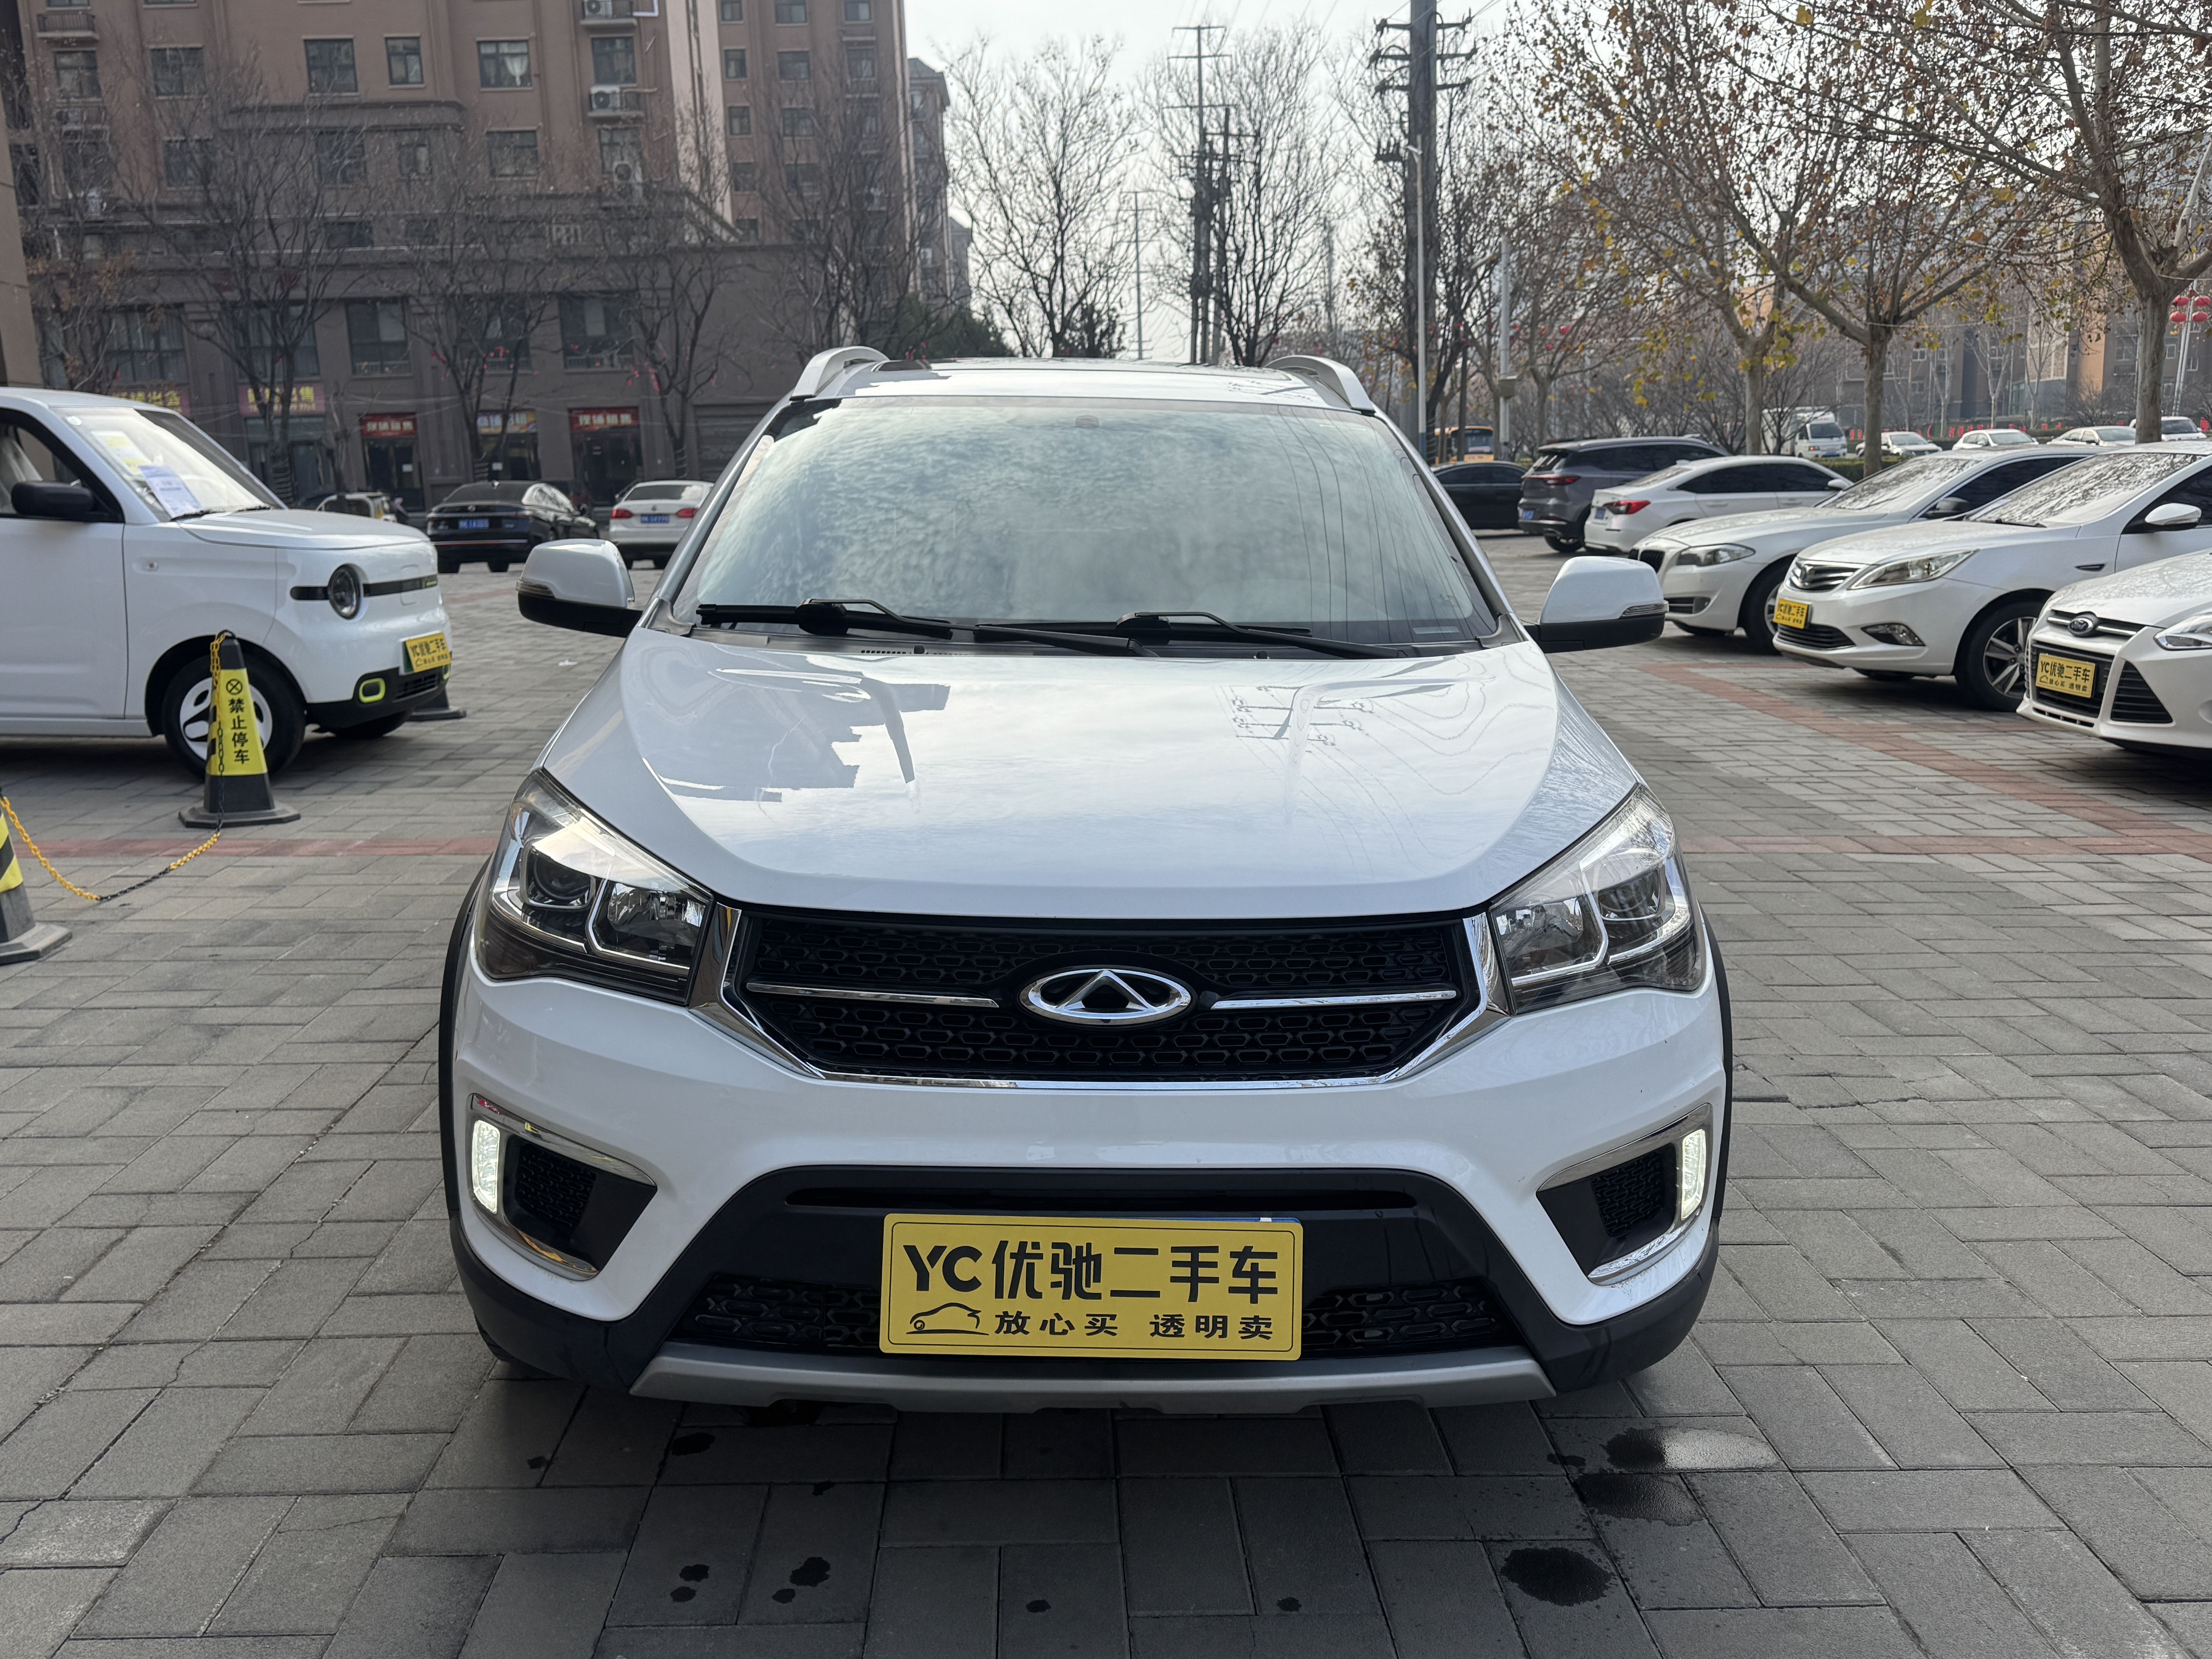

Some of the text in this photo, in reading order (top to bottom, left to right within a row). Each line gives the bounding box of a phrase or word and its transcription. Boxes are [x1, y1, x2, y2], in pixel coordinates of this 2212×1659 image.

[228, 698, 250, 764] 禁止停车
[903, 1240, 1278, 1304] YC优驰二手车
[994, 1310, 1273, 1340] 放心买 透明卖
